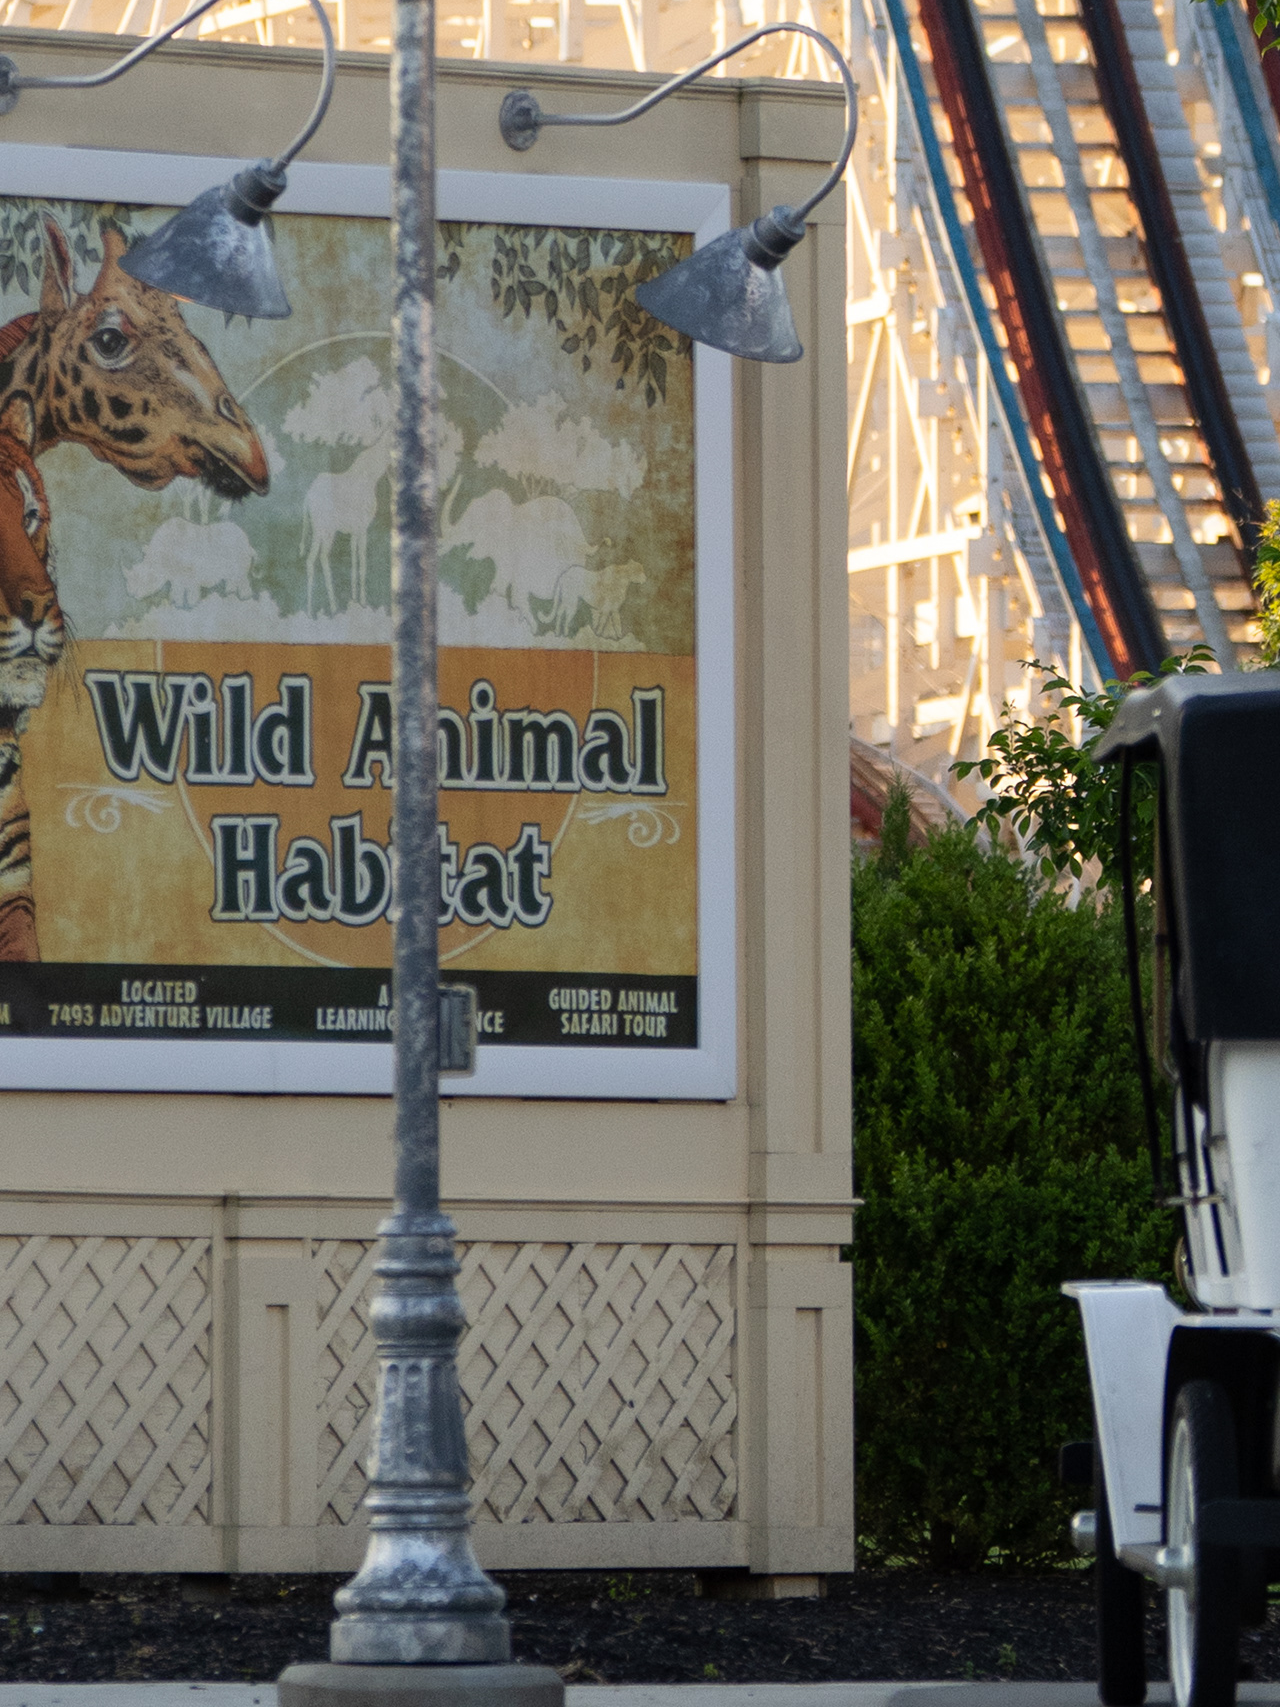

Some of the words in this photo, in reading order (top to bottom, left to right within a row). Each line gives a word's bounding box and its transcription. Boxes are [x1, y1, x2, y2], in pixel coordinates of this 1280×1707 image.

[84, 669, 315, 786] Wild
[211, 811, 554, 928] Habat
[121, 980, 198, 1004] LOCATED
[548, 988, 612, 1012] GUIDED
[617, 989, 679, 1014] ANIMAL
[48, 1004, 95, 1027] 7493
[99, 1005, 201, 1029] ADVENTURE
[206, 1006, 273, 1031] VILLAGE
[560, 1013, 618, 1036] SAFARI
[624, 1014, 668, 1038] TOUR
